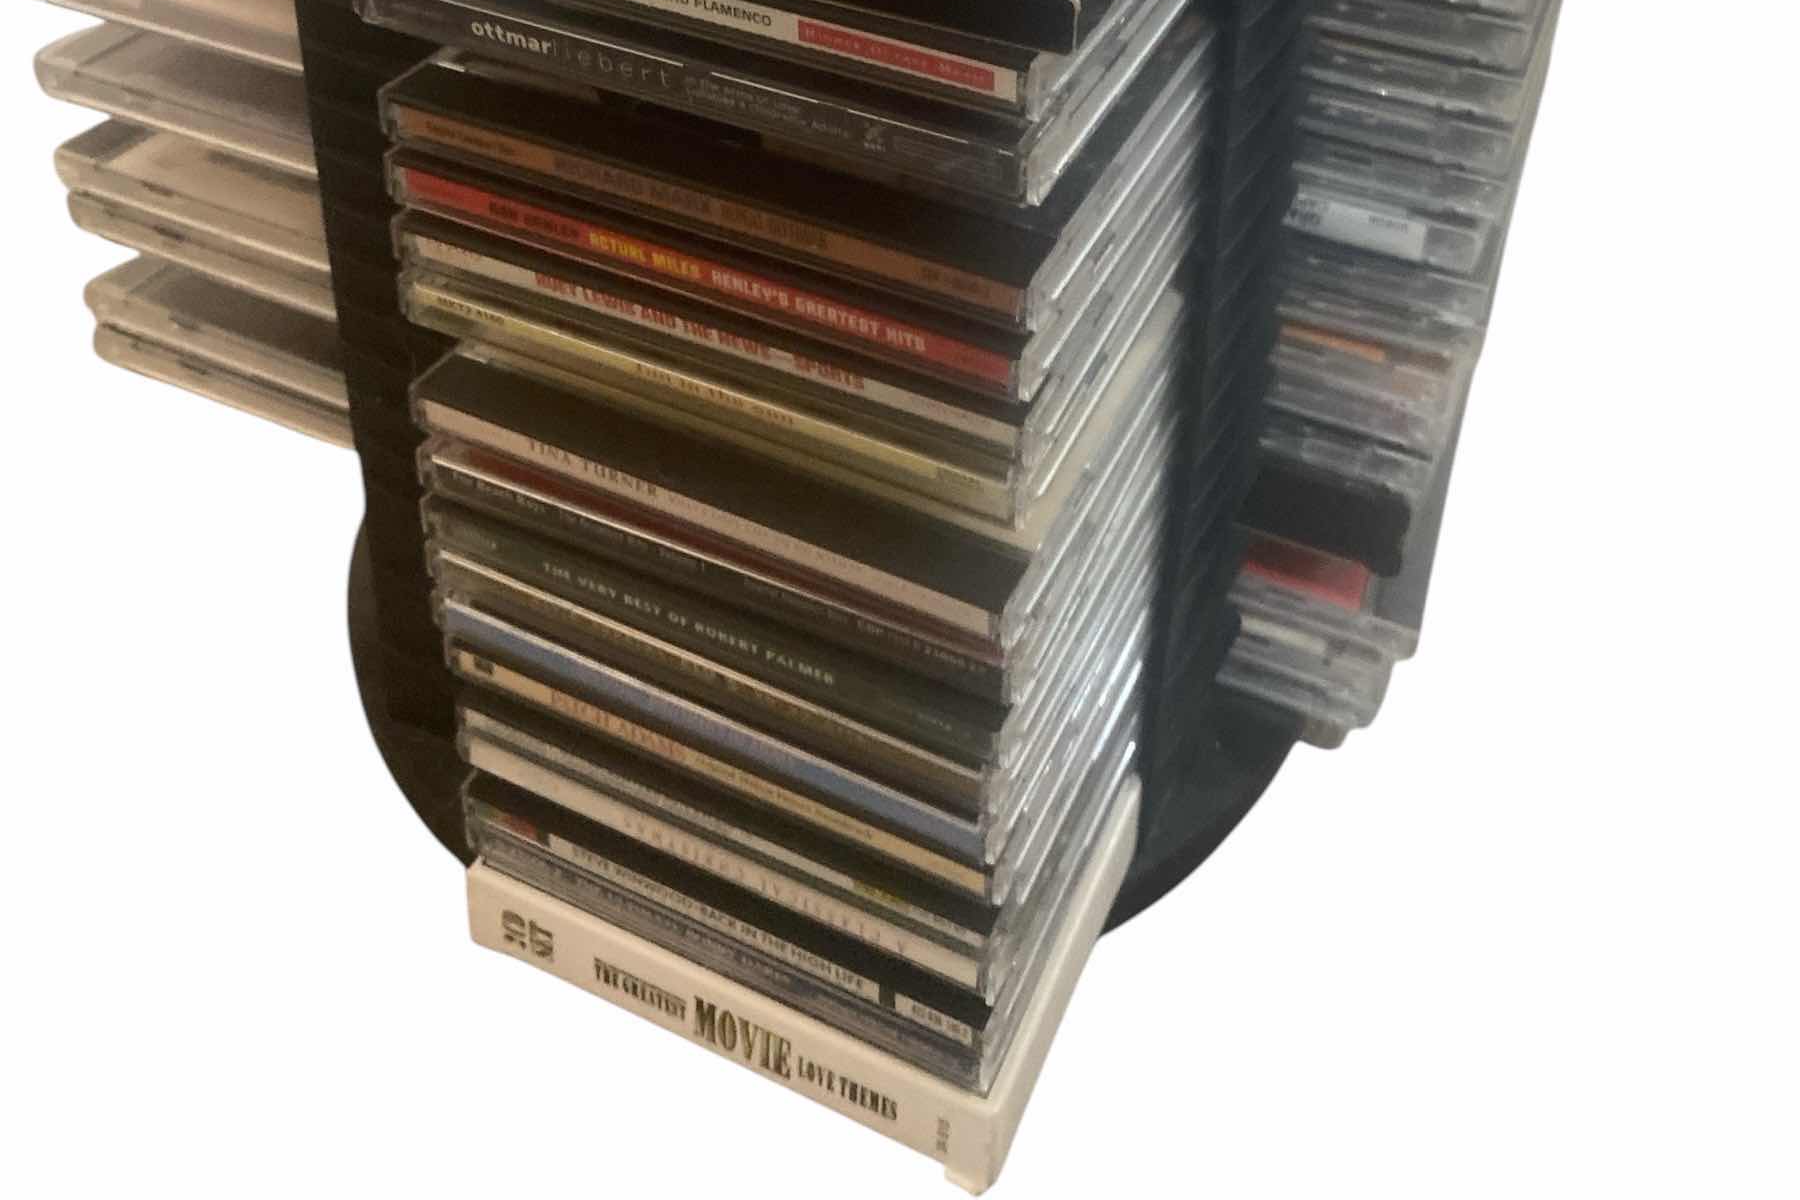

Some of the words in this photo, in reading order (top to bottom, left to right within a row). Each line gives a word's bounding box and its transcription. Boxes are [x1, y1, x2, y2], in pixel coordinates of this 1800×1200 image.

[795, 296, 881, 336] GREATEST
[885, 327, 927, 353] HITS
[694, 995, 792, 1081] MOVIE
[797, 1055, 835, 1091] LOVE
[839, 1075, 898, 1121] THEMES
